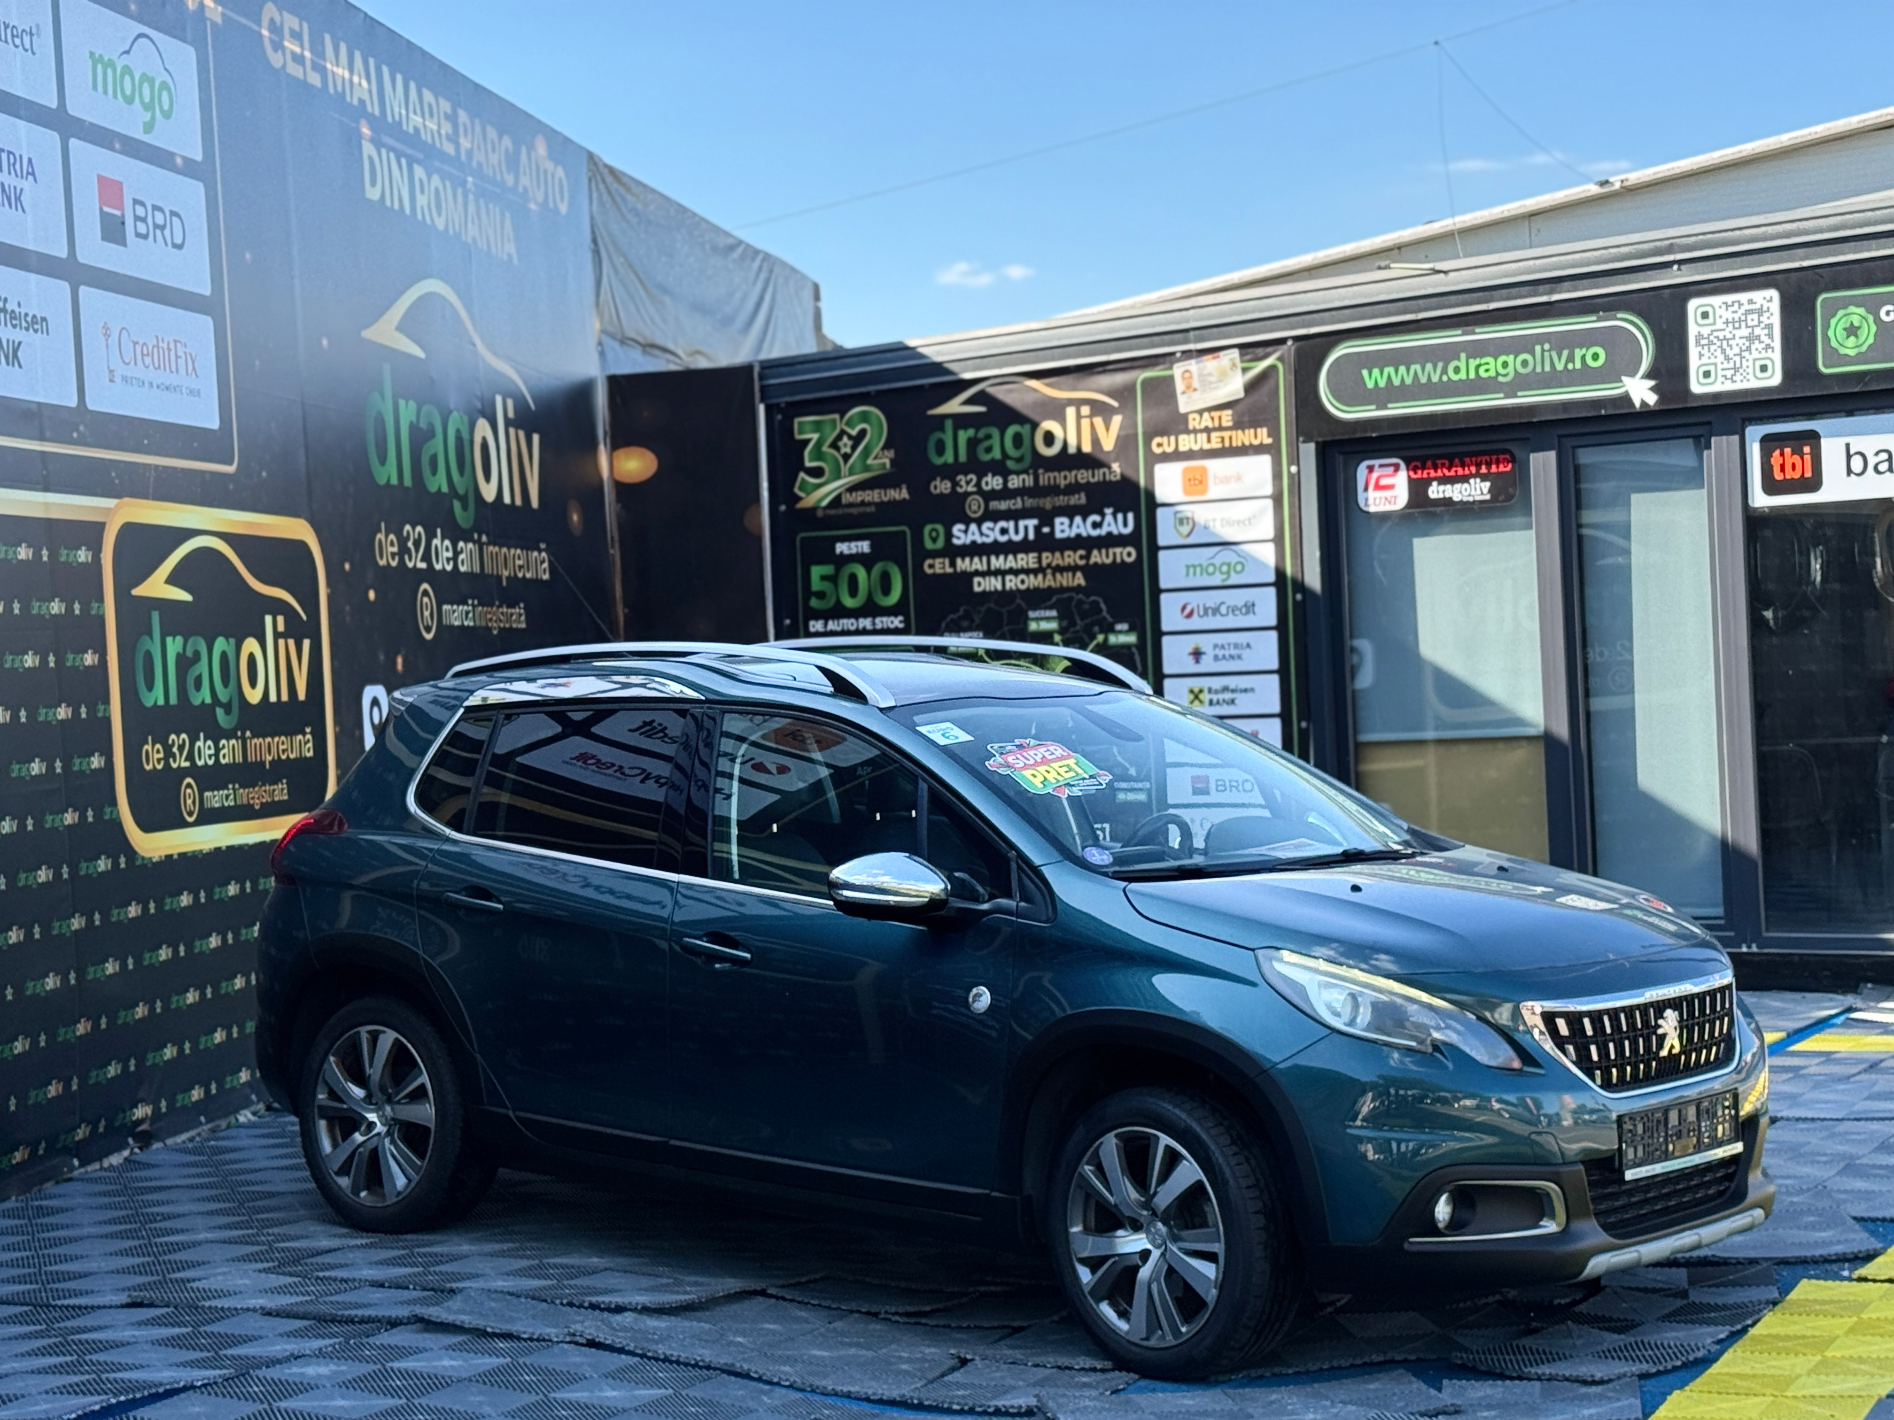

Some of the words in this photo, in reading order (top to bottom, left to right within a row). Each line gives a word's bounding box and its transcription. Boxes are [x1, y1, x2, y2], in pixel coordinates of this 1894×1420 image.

[89, 50, 174, 135] mogo
[260, 1, 322, 89] CEL
[324, 33, 380, 118] MAI
[381, 64, 456, 156] MARE
[457, 107, 515, 187] PARC
[518, 144, 568, 216] AUTO
[361, 139, 410, 216] DIN
[413, 175, 519, 265] ROMÂNIA
[132, 197, 186, 251] BRD
[118, 326, 199, 379] CreditFix
[1361, 343, 1606, 389] www.dragoliv.ro
[1188, 409, 1233, 430] RATE
[366, 362, 540, 529] dragoliv
[794, 405, 889, 497] 32
[927, 405, 1123, 472] dragoliv
[1151, 436, 1176, 454] CU
[1178, 427, 1273, 452] BULETINUL
[1408, 454, 1513, 479] GARANTIE
[1771, 445, 1812, 481] tbi
[930, 476, 951, 495] de
[956, 474, 978, 493] 32
[981, 472, 1003, 491] de
[1009, 468, 1034, 488] ani
[1039, 462, 1122, 489] împreună
[1187, 474, 1204, 487] tbi
[1213, 472, 1244, 486] bank
[1428, 478, 1491, 502] dragoliv
[989, 496, 1022, 511] marcă
[1024, 491, 1087, 510] înregistrată
[1364, 496, 1398, 508] LUNI
[952, 518, 1039, 546] SASCUT
[1054, 507, 1134, 539] BACĂU
[59, 545, 92, 566] dragoliv
[375, 522, 399, 568] de
[403, 524, 428, 569] 32
[431, 527, 453, 572] de
[457, 533, 480, 573] ani
[481, 533, 549, 586] împreună
[835, 541, 871, 555] PESTE
[923, 557, 954, 575] CEL
[956, 555, 987, 573] MAI
[989, 552, 1039, 571] MARE
[1041, 549, 1086, 567] PARC
[1089, 546, 1137, 565] AUTO
[973, 576, 1003, 592] DIN
[1005, 570, 1086, 591] ROMÂNIA
[1184, 560, 1245, 583] mogo
[809, 561, 902, 610] 500
[31, 598, 65, 618] dragoliv
[442, 598, 474, 627] marcă
[1196, 601, 1256, 618] UniCredit
[809, 620, 826, 633] DE
[827, 618, 857, 632] AUTO
[858, 617, 875, 630] PE
[876, 616, 904, 629] STOC
[1213, 642, 1252, 651] PATRIA
[1213, 653, 1244, 663] BANK
[4, 650, 39, 672] dragoliv
[65, 649, 99, 670] dragoliv
[135, 610, 311, 729] dragoliv
[1207, 685, 1255, 695] Raiffeisen
[1208, 698, 1237, 707] BANK
[37, 703, 72, 725] dragoliv
[142, 736, 164, 771] de
[168, 733, 190, 769] 32
[194, 732, 215, 766] de
[219, 731, 243, 764] ani
[245, 726, 313, 769] împreună
[941, 731, 959, 741] 6
[10, 758, 46, 779] dragoliv
[72, 752, 105, 774] dragoliv
[1006, 745, 1068, 769] SUPER
[1022, 758, 1089, 789] PREȚ
[1215, 778, 1255, 793] BRD
[204, 784, 234, 809] marcă
[235, 779, 288, 810] înregistrată
[44, 807, 79, 830] dragoliv
[17, 865, 53, 888] dragoliv
[79, 855, 112, 877] dragoliv
[51, 913, 86, 936] dragoliv
[110, 901, 142, 923] dragoliv
[25, 972, 61, 996] dragoliv
[87, 957, 120, 980] dragoliv
[56, 1017, 92, 1042] dragoliv
[28, 1079, 63, 1106] dragoliv
